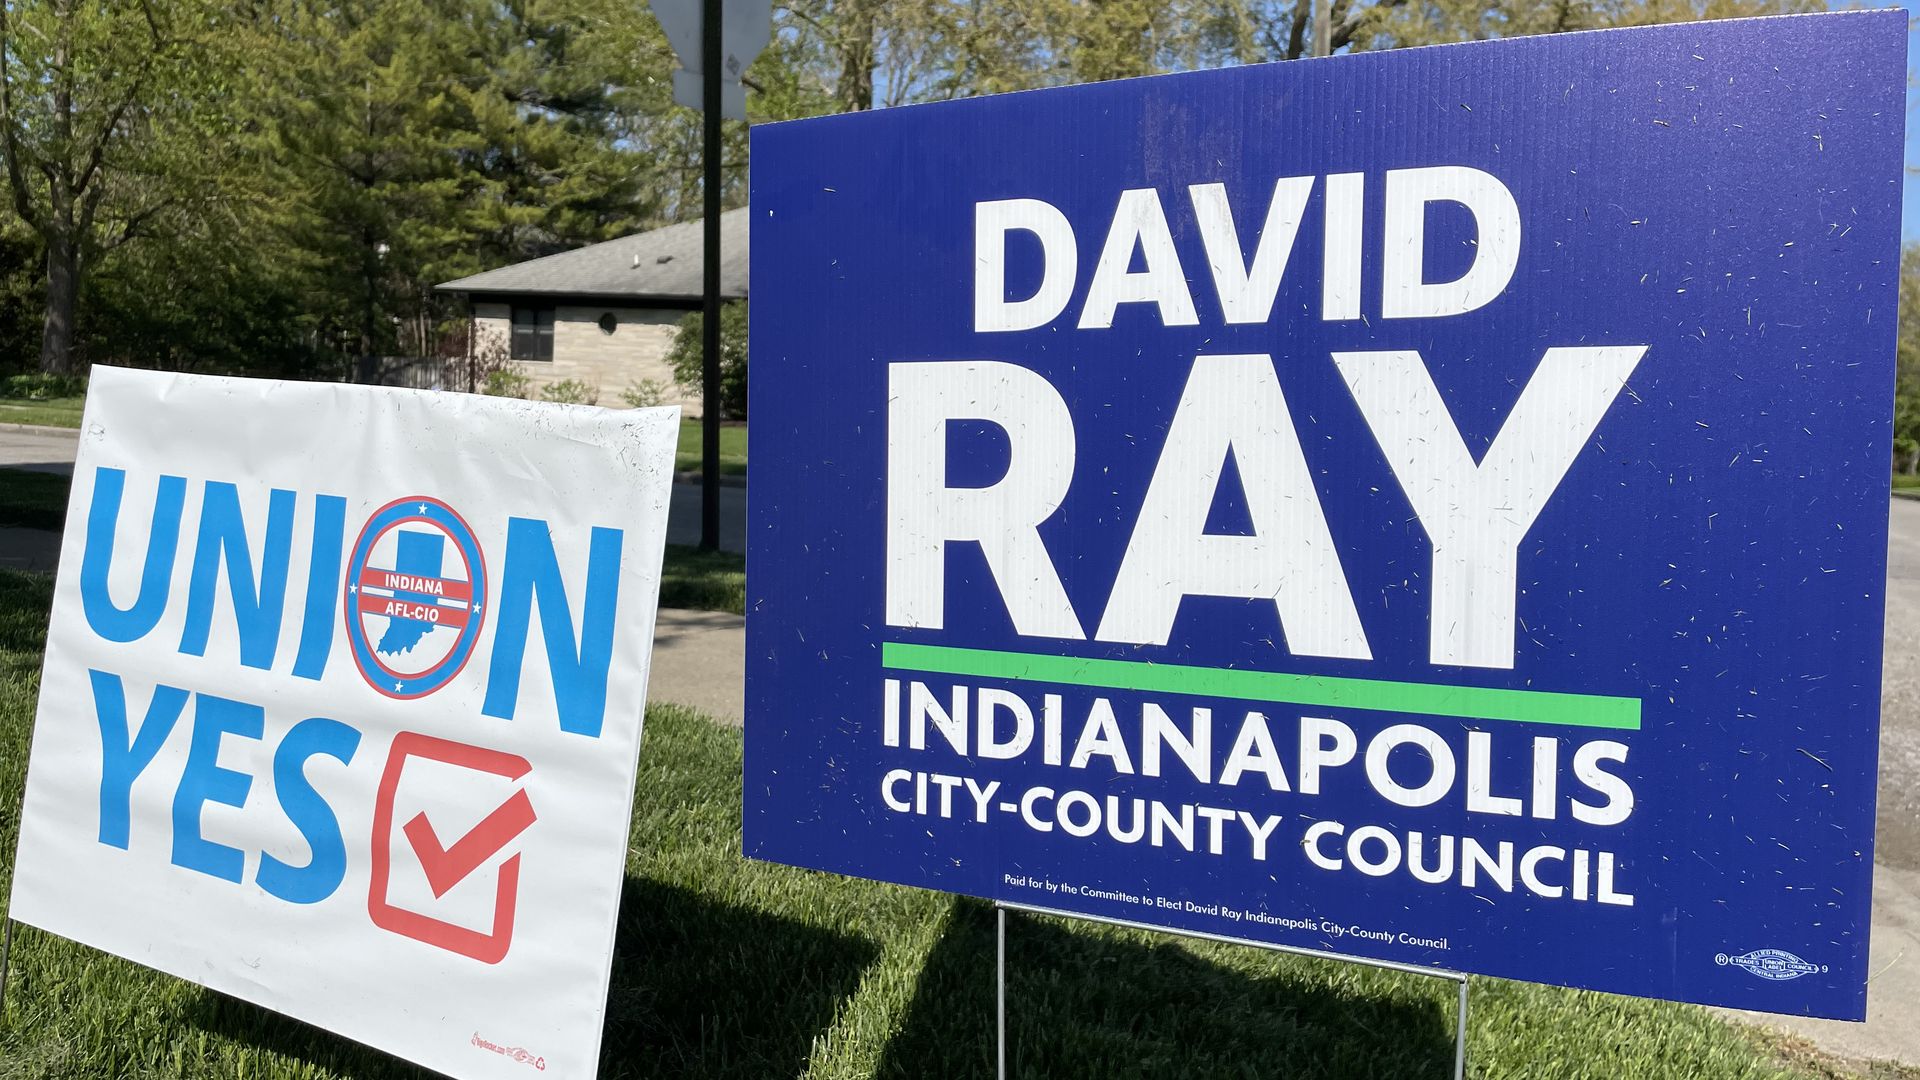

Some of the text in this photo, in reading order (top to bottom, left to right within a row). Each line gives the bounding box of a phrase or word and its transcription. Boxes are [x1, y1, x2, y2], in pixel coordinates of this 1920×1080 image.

[974, 165, 1522, 333] DAVID
[885, 345, 1649, 670] RAY
[80, 466, 624, 739] UNION
[385, 573, 443, 595] INDIANA
[385, 601, 439, 623] AFL-CIO
[88, 668, 363, 905] YES
[883, 678, 1634, 826] INDIANAPOLIS
[881, 769, 1634, 906] CITY-COUNTY COUNCIL
[1004, 873, 1451, 951] Paid for by the Committee to Elect David Ray Indianapolis City-County Council.
[1821, 965, 1828, 973] 9
